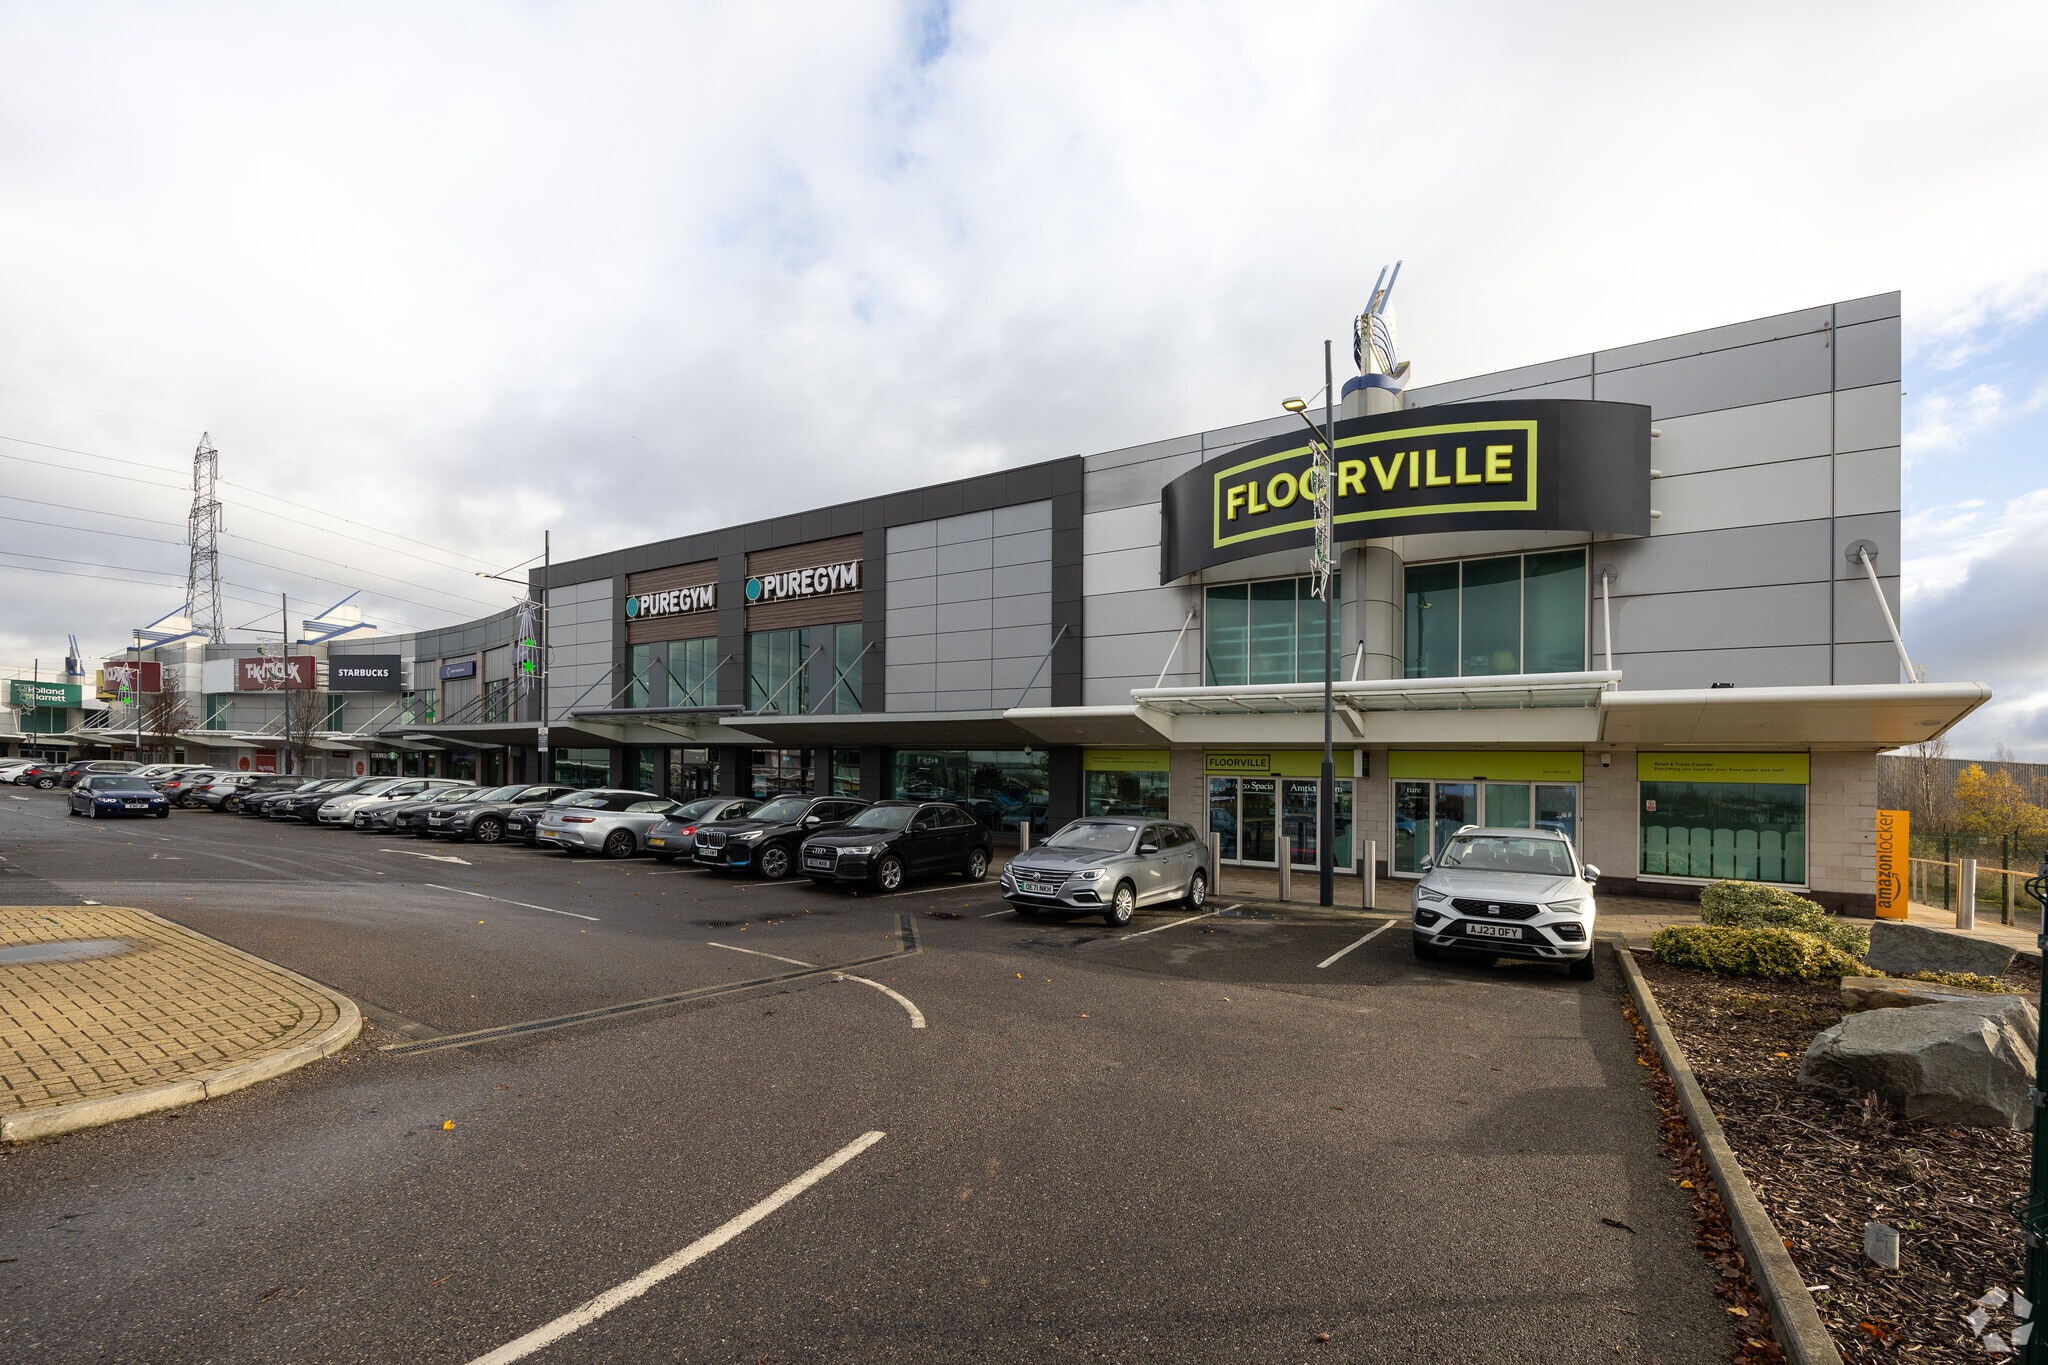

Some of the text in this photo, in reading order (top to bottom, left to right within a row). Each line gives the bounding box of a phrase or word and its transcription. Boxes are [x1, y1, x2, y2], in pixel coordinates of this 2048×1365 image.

[1226, 443, 1514, 521] FLOORVILLE
[763, 562, 858, 599] PUREGYM
[640, 584, 714, 616] PUREGYM
[338, 668, 389, 678] STARBUCKS
[28, 686, 65, 697] Holland
[33, 693, 66, 703] Barrett
[1209, 757, 1267, 767] FLOORVILLE
[1251, 781, 1274, 791] Spacia
[1470, 925, 1518, 937] AJ23 OFY
